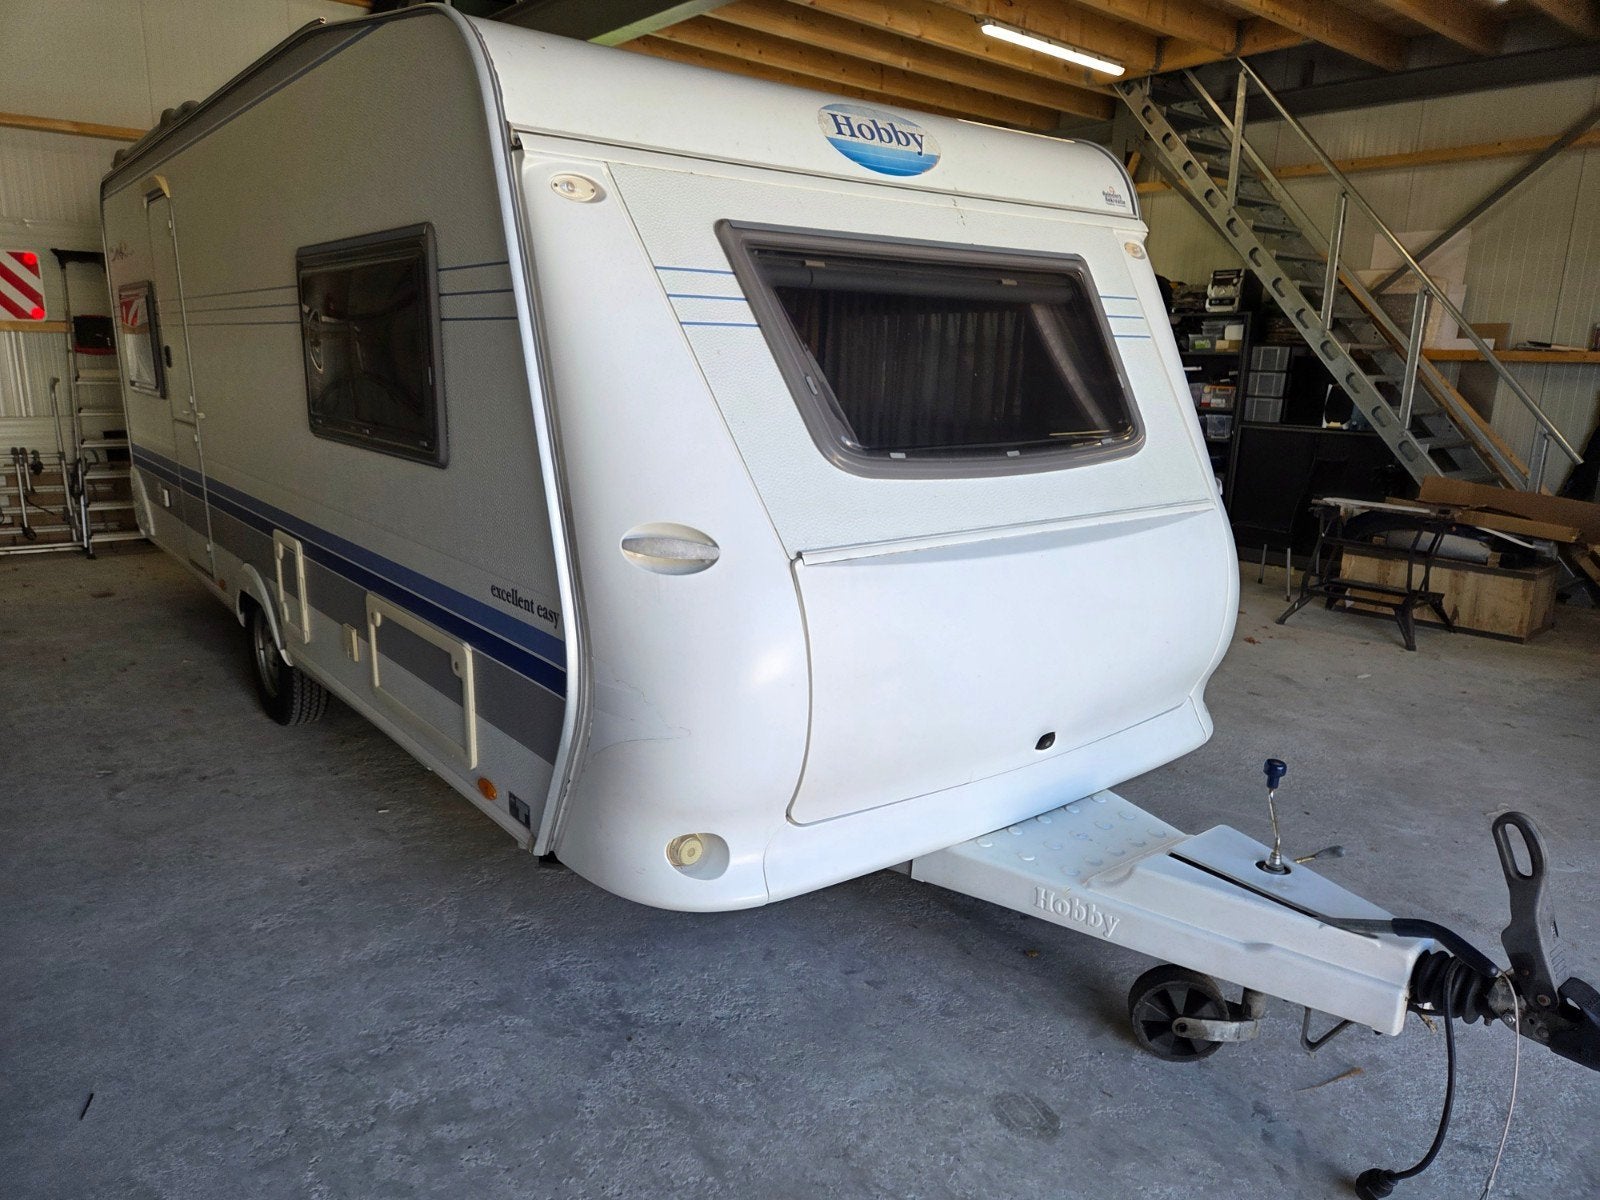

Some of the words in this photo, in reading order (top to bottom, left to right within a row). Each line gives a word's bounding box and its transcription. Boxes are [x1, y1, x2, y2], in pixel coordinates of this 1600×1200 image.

[827, 112, 925, 156] Hobby
[490, 584, 535, 615] excellent
[536, 604, 561, 629] easy
[1033, 886, 1120, 938] Hobby
